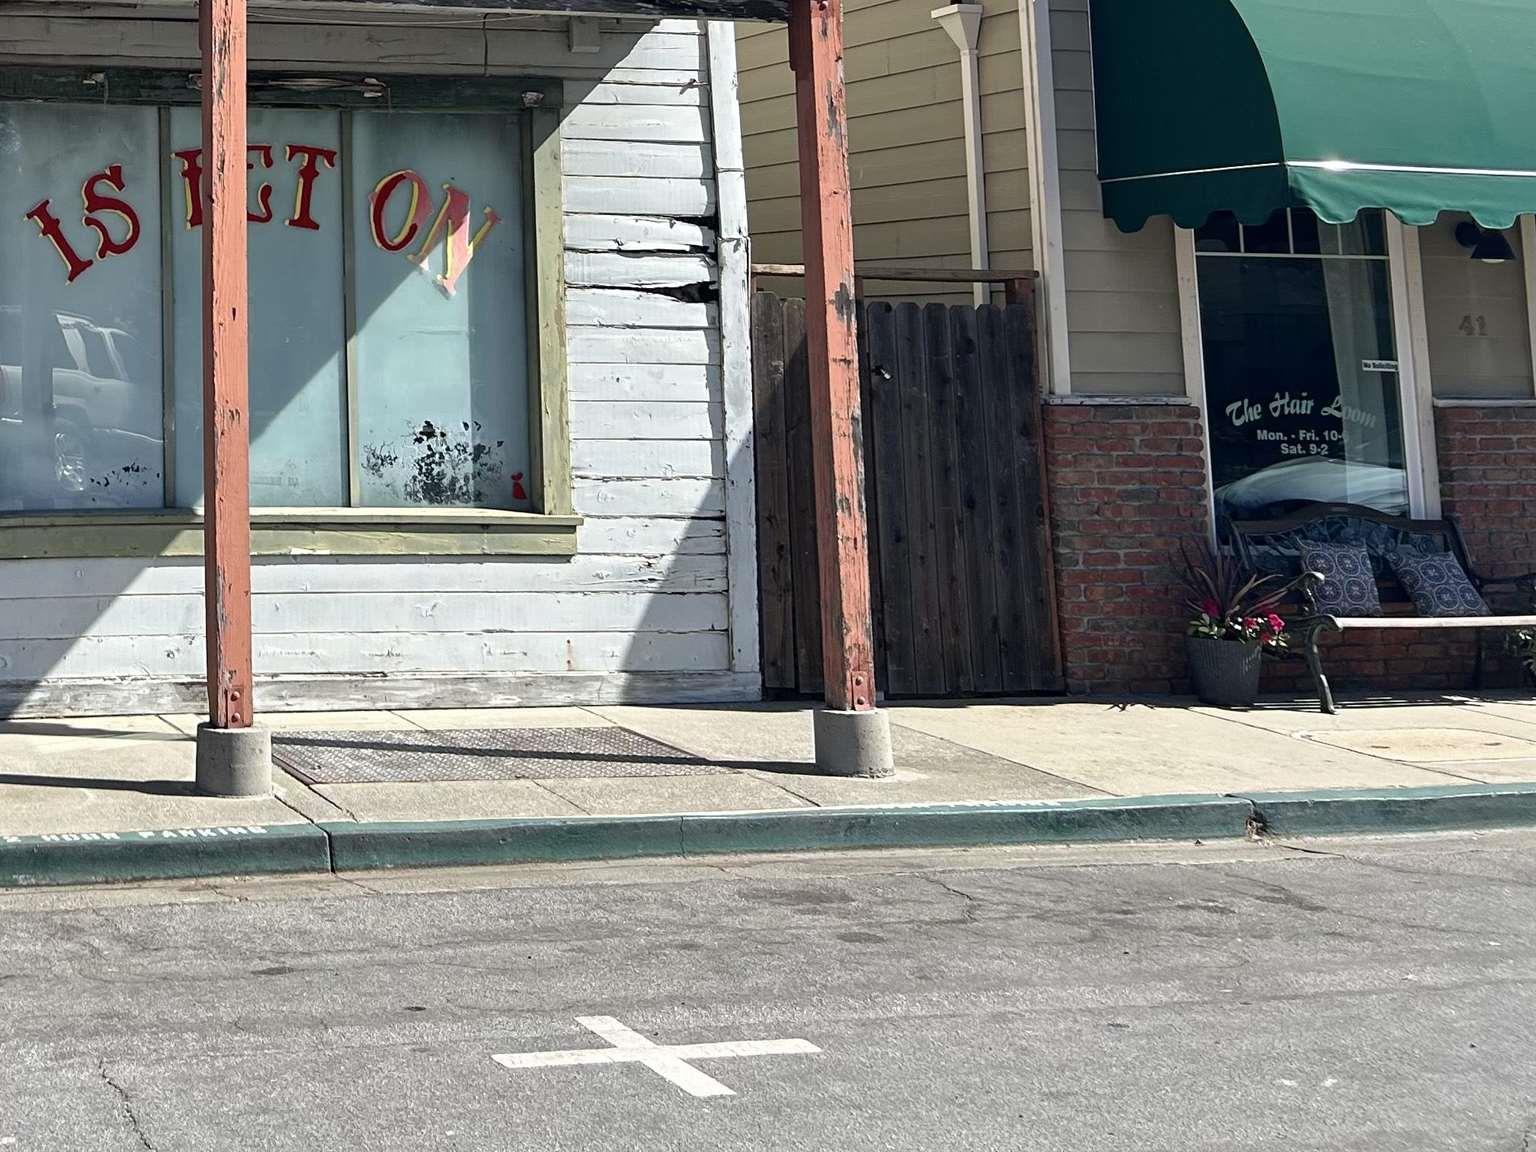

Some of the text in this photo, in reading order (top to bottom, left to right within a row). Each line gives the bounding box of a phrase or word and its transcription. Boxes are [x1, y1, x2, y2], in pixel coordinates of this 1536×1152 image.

[1225, 398, 1263, 427] The
[1268, 391, 1315, 418] Hair
[1256, 429, 1288, 441] Mon.
[1298, 429, 1320, 441] Fri.
[1280, 443, 1306, 455] Sat.
[137, 826, 268, 838] PARKING
